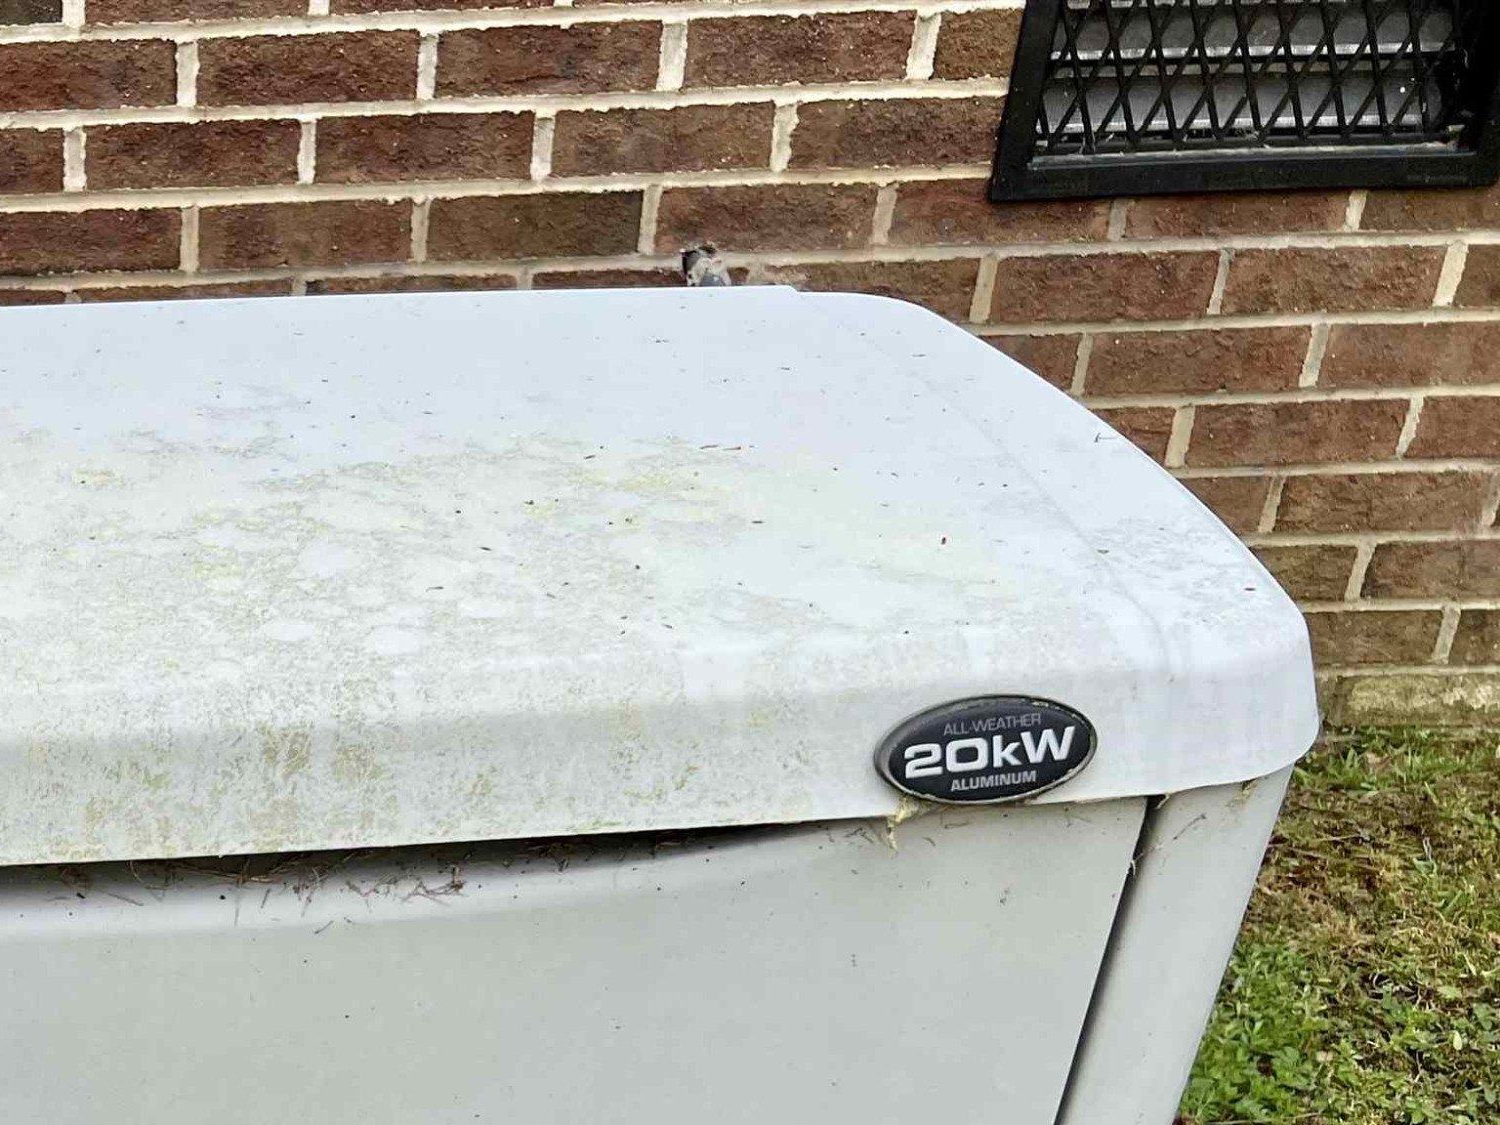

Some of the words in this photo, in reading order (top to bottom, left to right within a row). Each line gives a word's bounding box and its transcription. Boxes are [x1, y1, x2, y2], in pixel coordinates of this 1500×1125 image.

[943, 713, 1042, 737] ALL-WEATHER
[903, 726, 1076, 779] 20kW
[950, 770, 1038, 792] ALUMINUM
